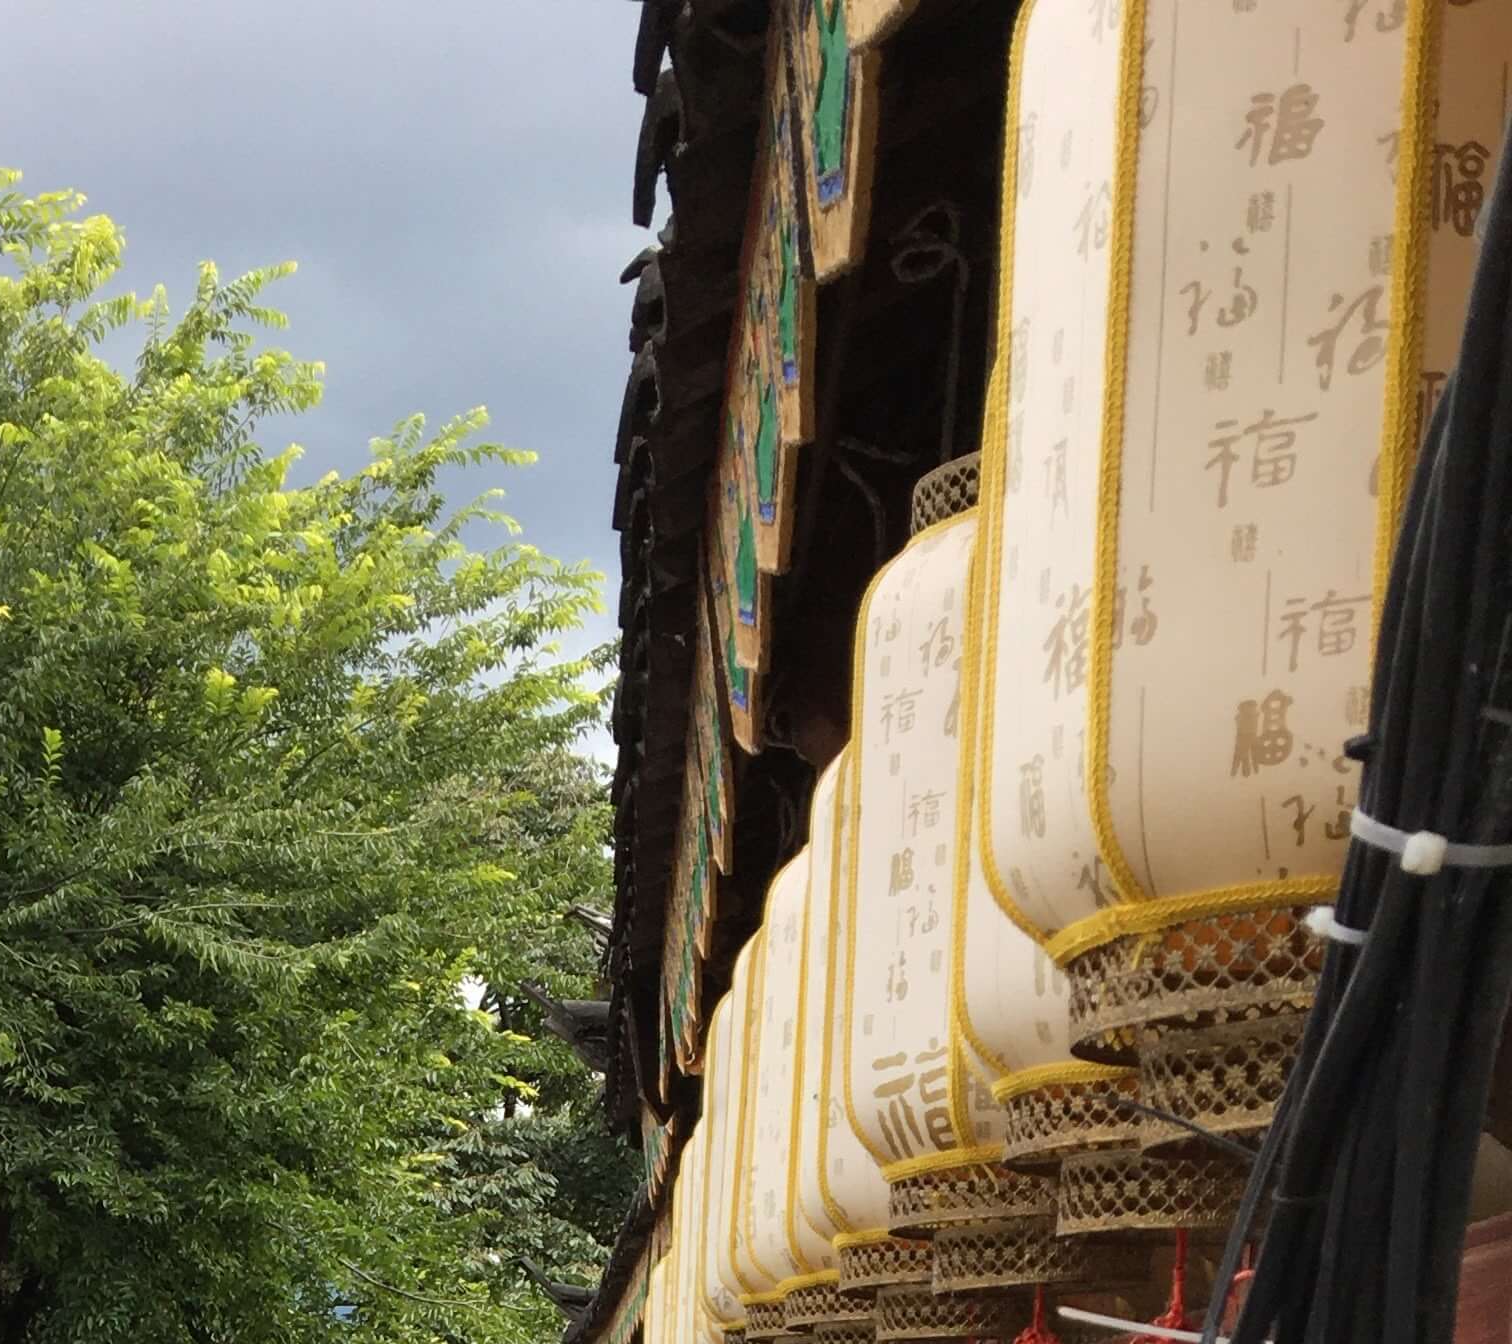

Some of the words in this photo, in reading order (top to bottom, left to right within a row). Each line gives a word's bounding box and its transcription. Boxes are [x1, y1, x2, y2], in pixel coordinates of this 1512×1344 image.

[1235, 84, 1325, 167] 福
[1205, 409, 1319, 508] 福
[1279, 589, 1373, 672] 福
[881, 688, 924, 745] 福
[1230, 689, 1294, 778] 福
[908, 789, 948, 837] 福
